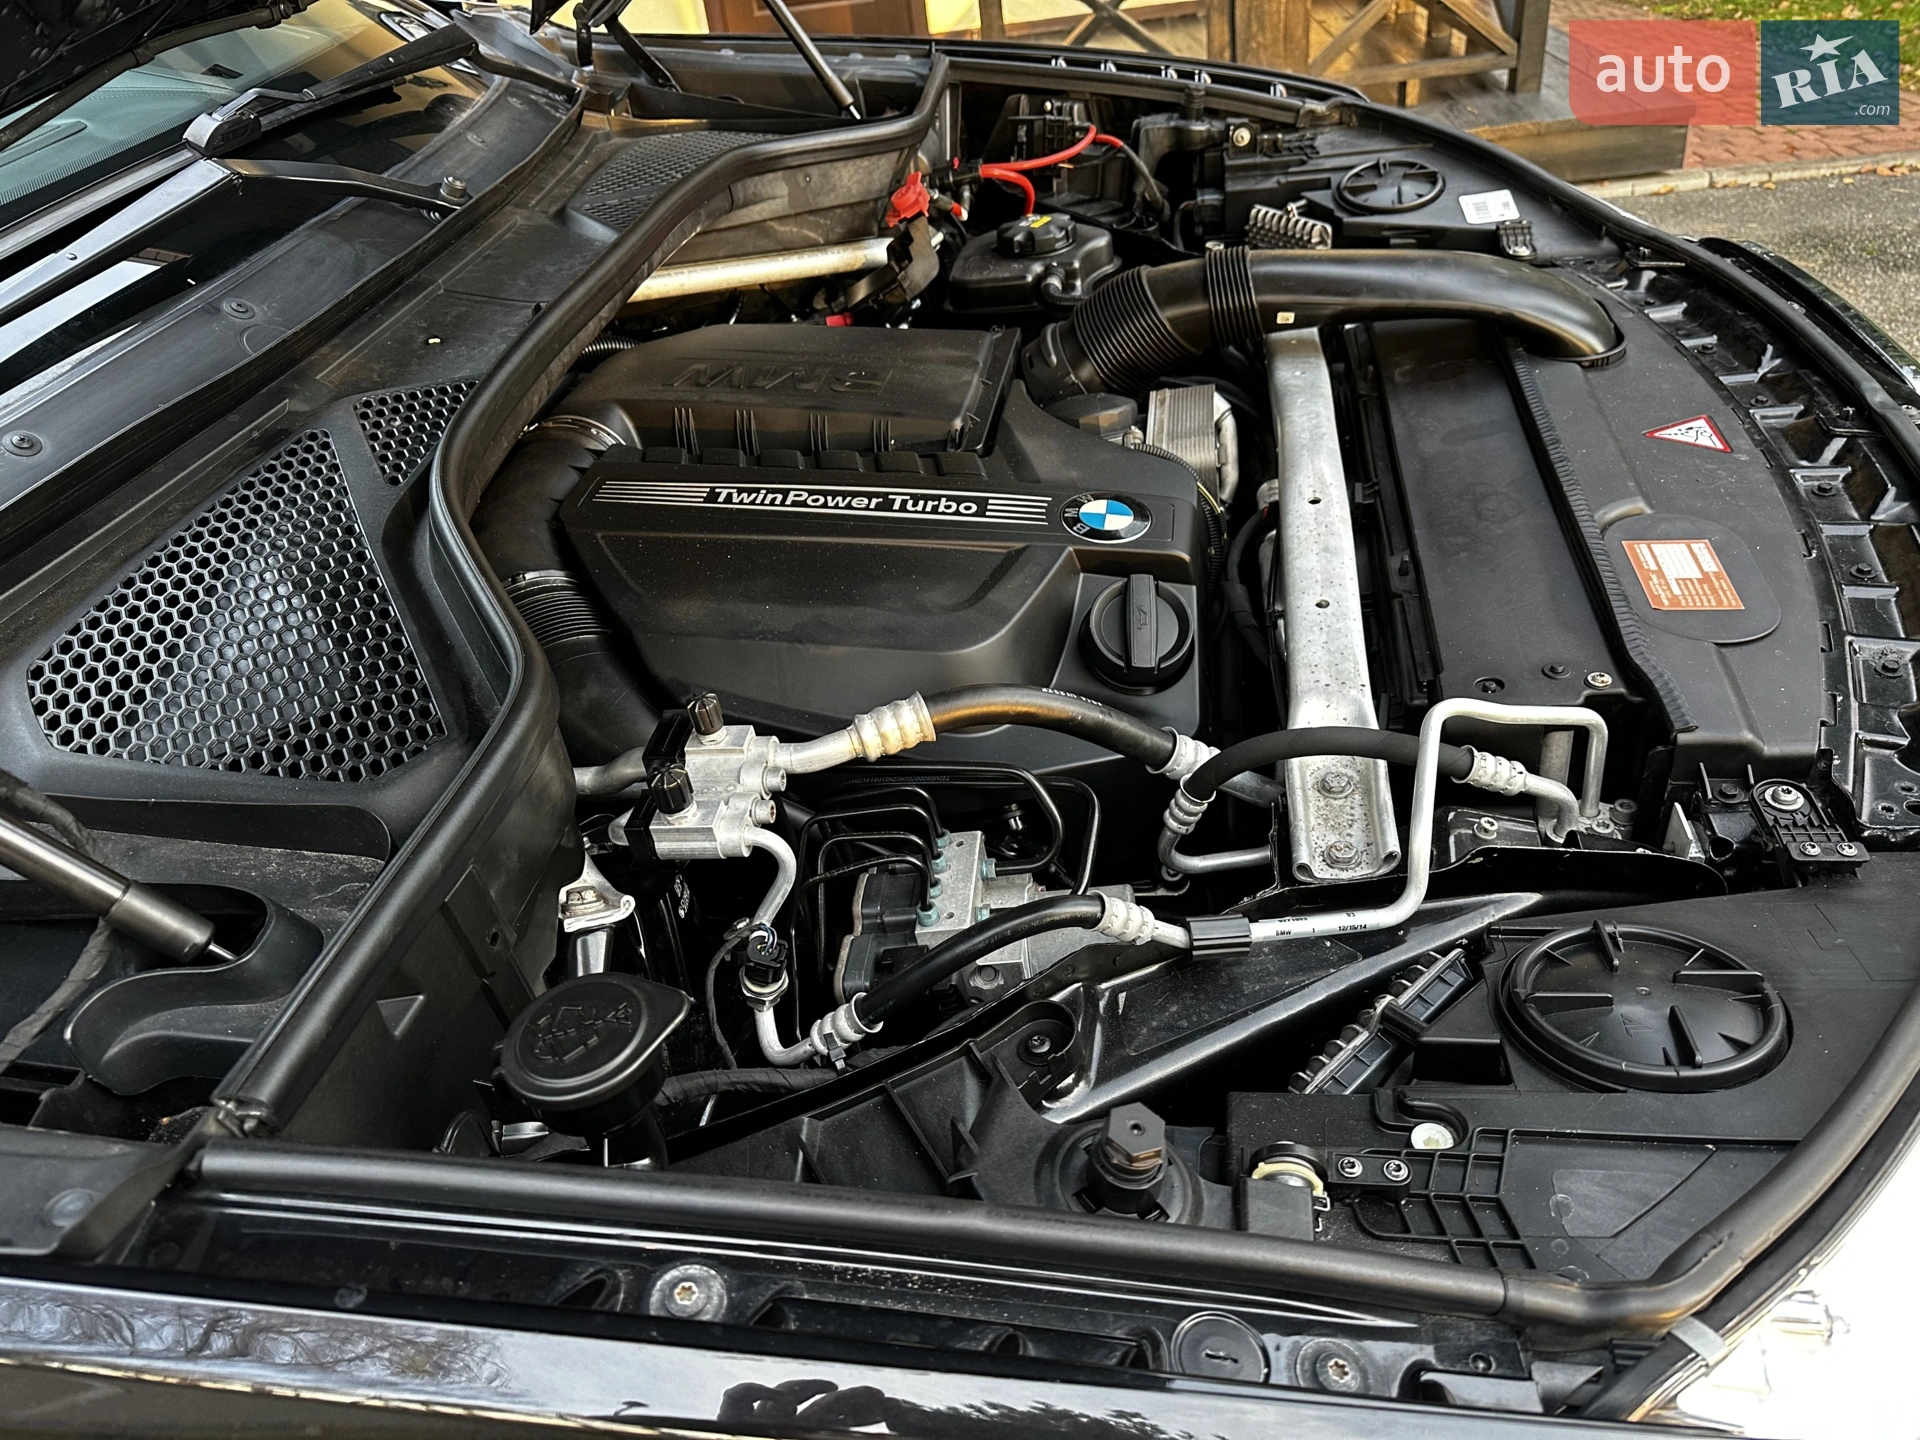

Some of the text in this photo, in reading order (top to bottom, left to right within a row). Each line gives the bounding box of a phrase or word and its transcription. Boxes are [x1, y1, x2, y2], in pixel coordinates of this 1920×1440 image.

[714, 488, 978, 515] TwinPower Turbo
[1338, 923, 1368, 932] 12/15/14
